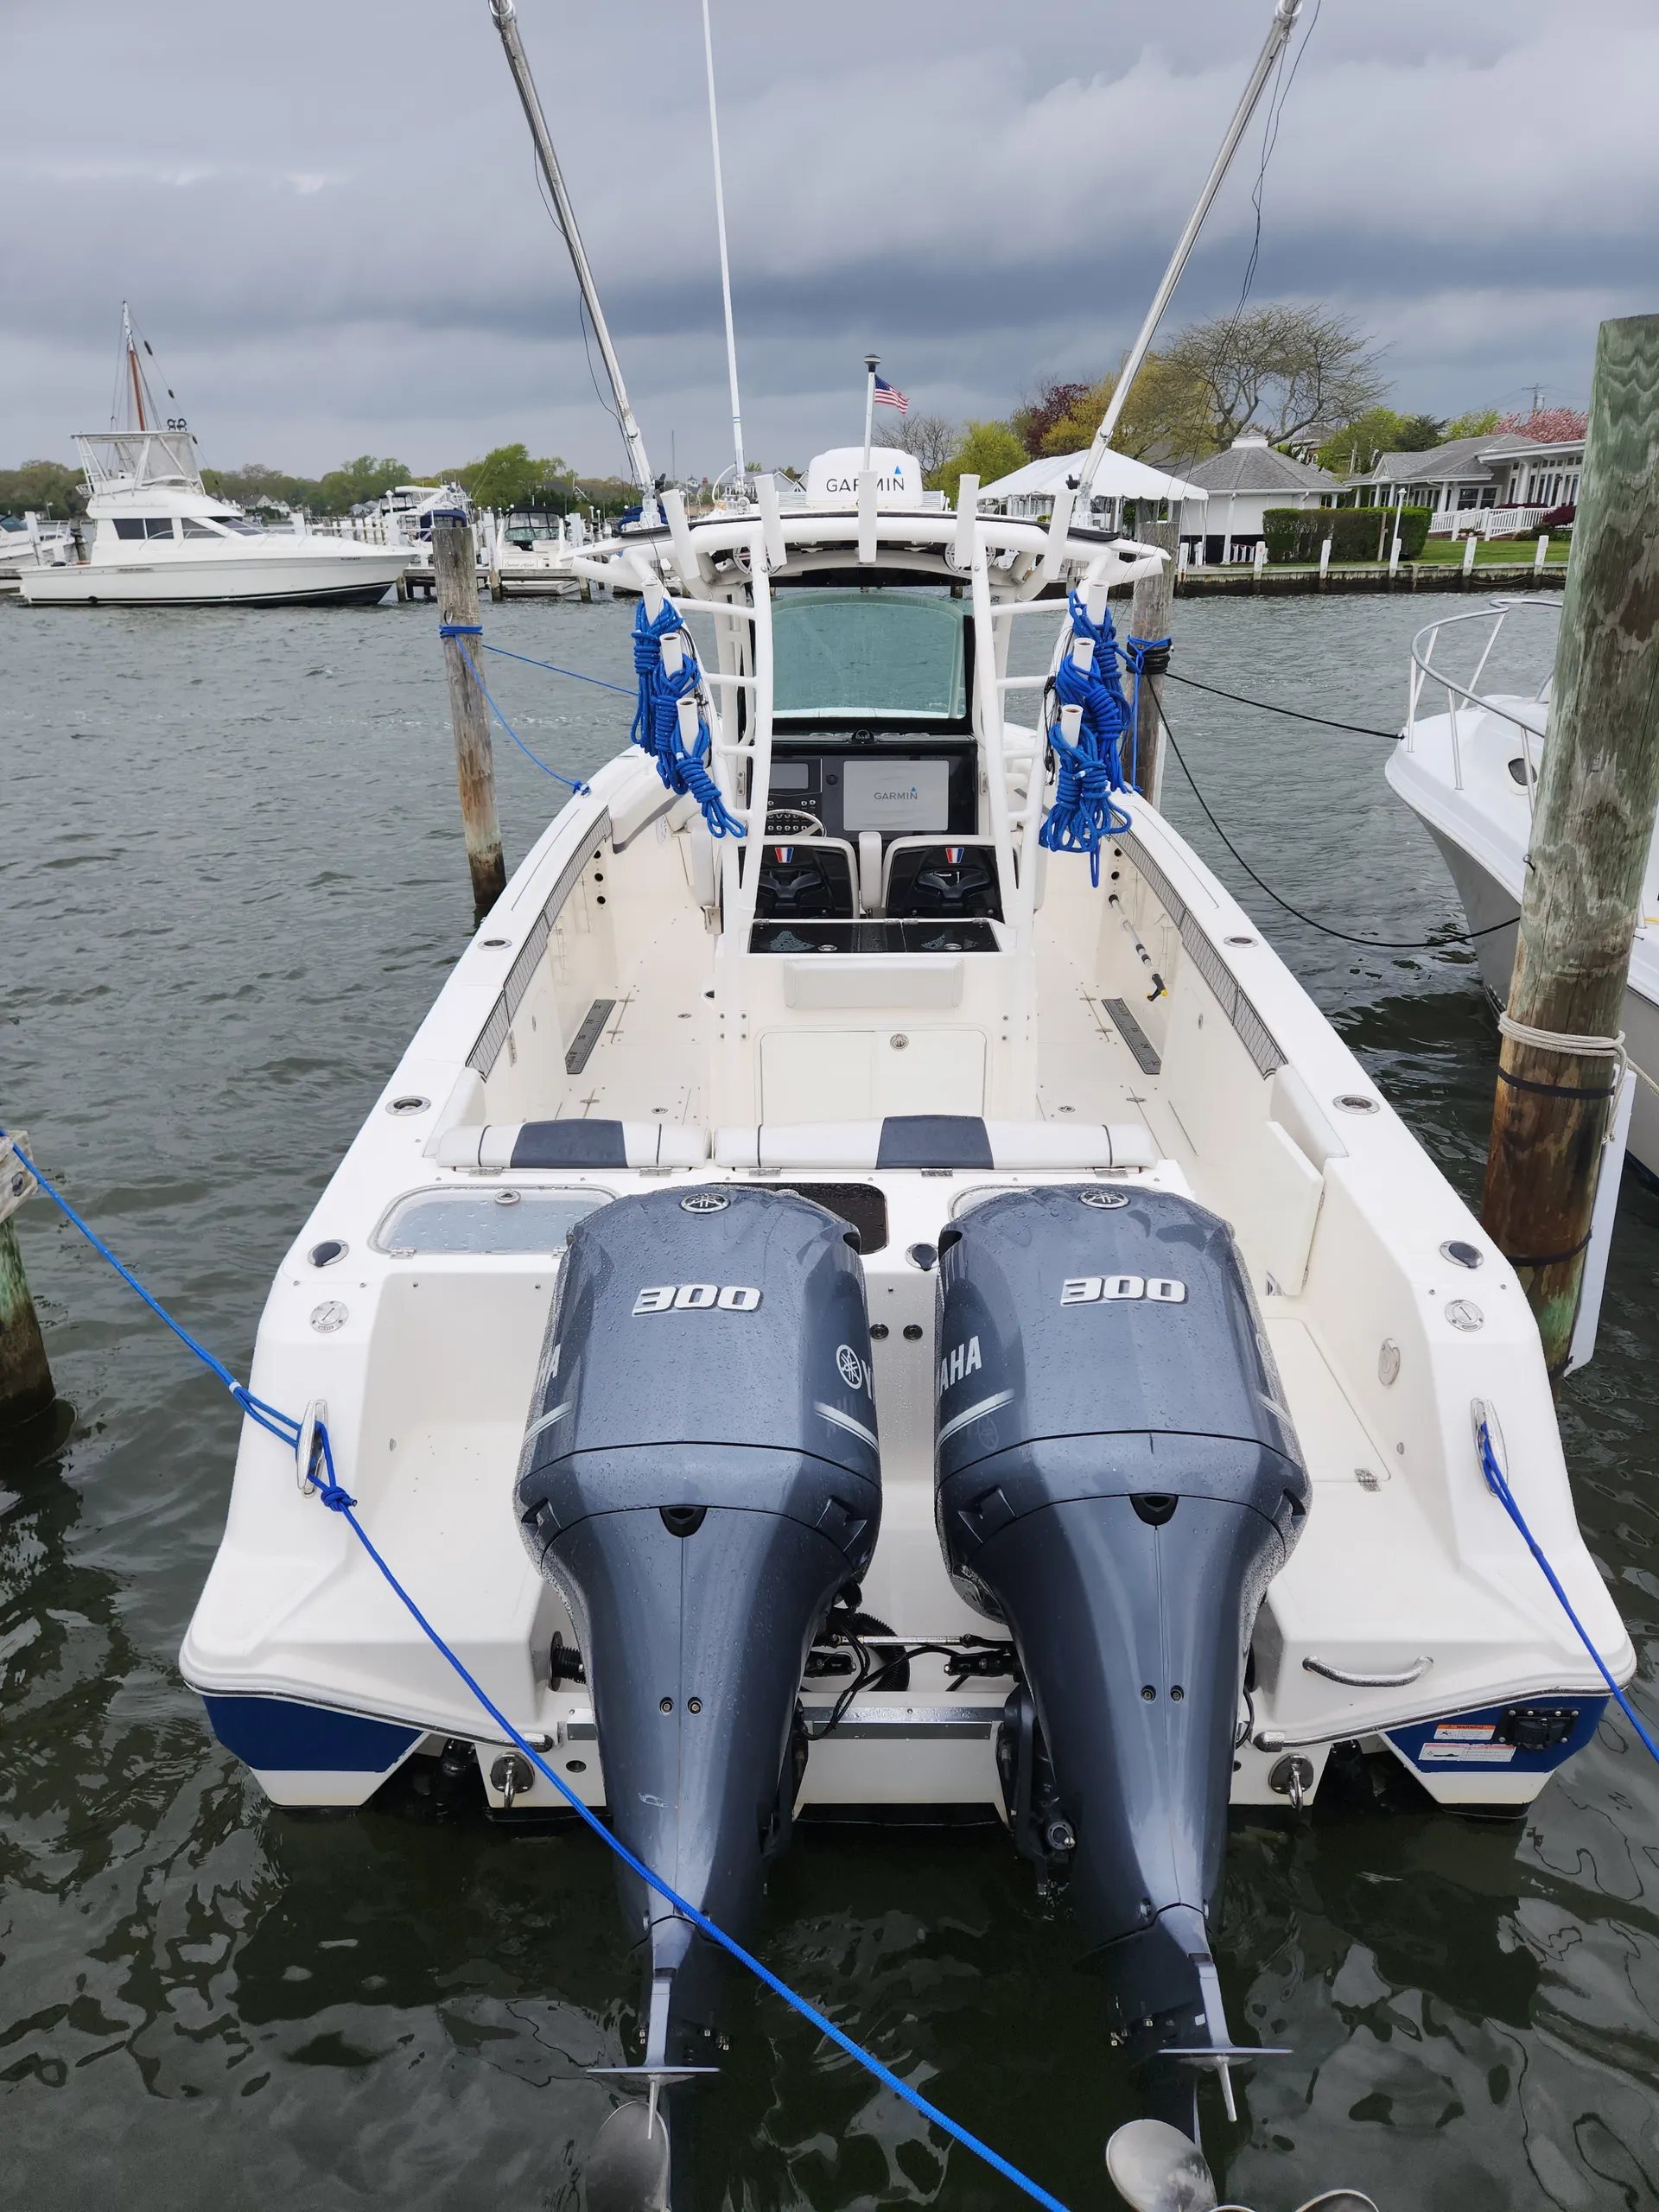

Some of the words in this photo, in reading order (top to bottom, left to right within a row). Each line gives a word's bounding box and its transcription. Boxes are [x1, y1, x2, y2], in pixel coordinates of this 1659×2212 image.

[874, 791, 918, 800] GARMIN
[632, 1284, 762, 1314] 300
[1061, 1275, 1186, 1305] 300
[936, 1335, 982, 1398] AHA
